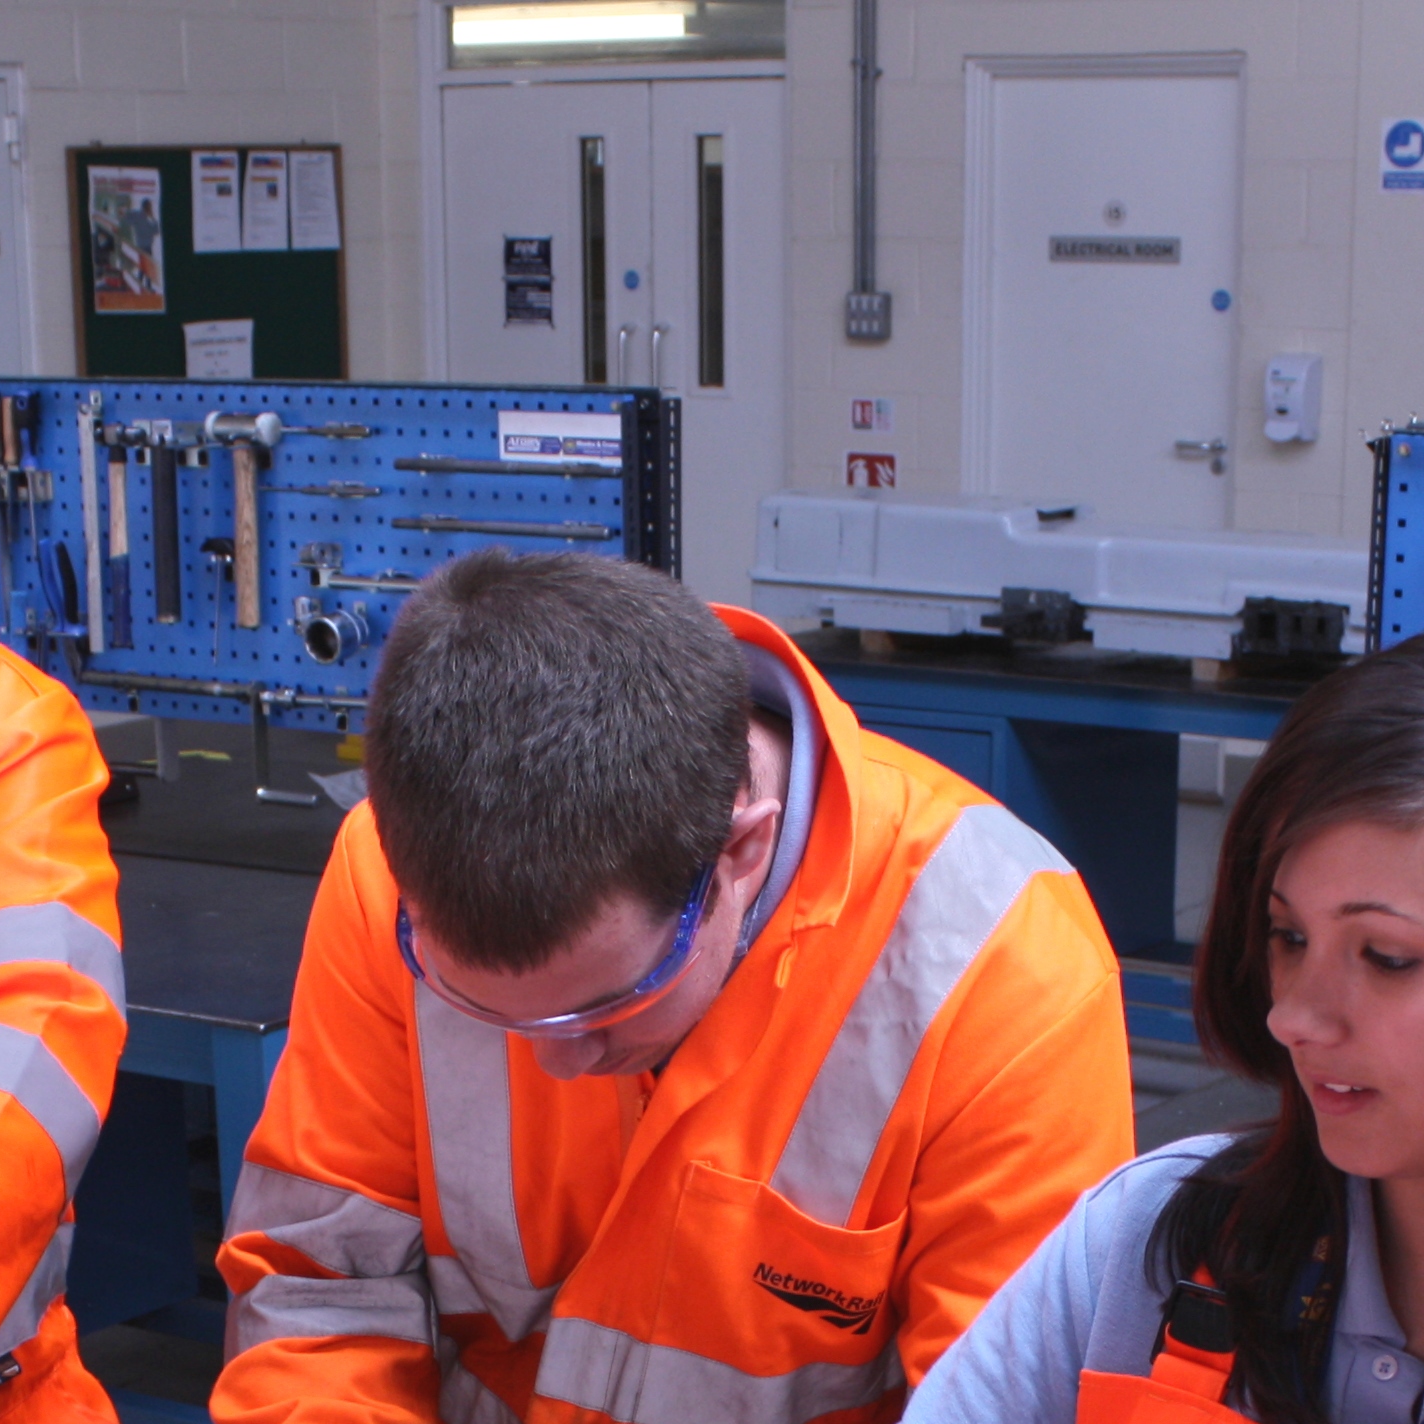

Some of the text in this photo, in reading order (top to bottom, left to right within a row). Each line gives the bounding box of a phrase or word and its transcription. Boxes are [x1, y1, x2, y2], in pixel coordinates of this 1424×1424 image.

[1055, 242, 1174, 256] ELECTRICAL ROOM
[752, 1262, 848, 1307] Network
